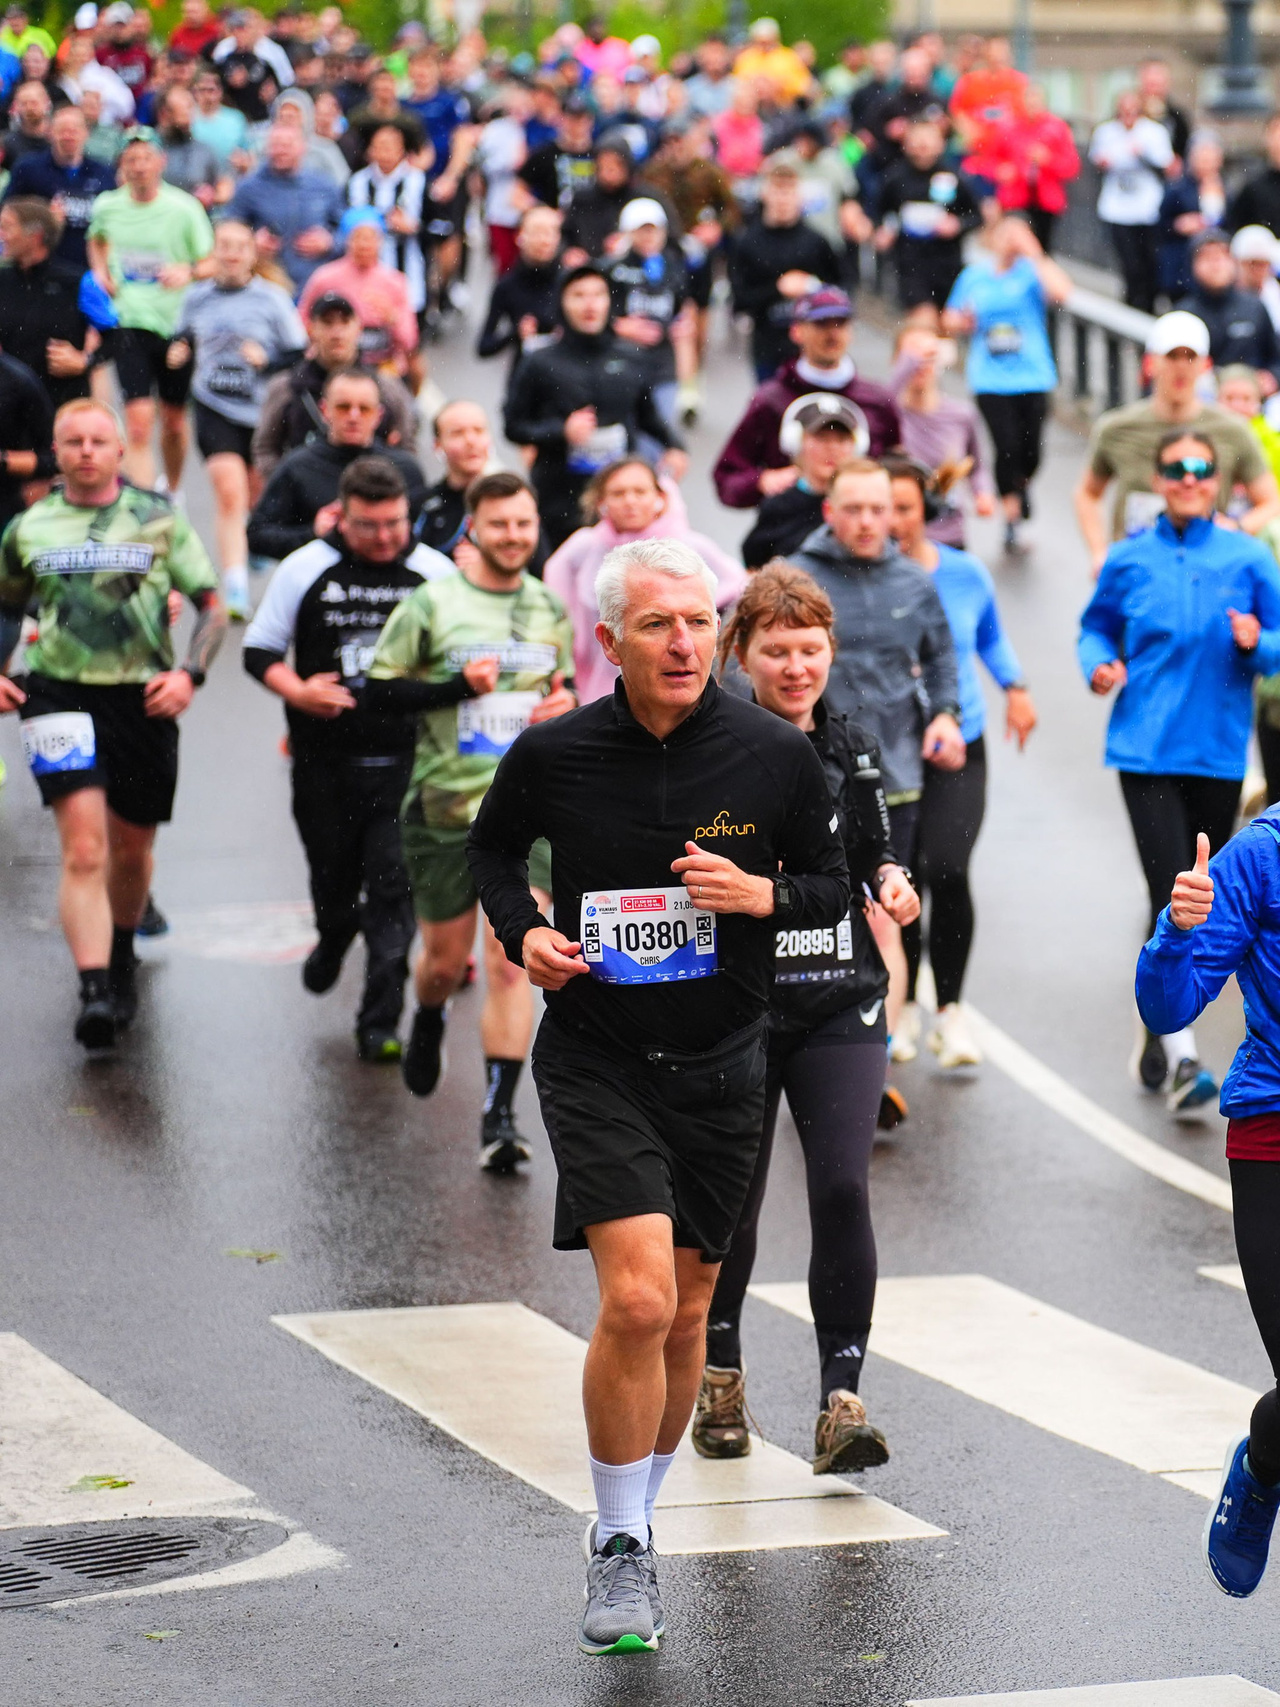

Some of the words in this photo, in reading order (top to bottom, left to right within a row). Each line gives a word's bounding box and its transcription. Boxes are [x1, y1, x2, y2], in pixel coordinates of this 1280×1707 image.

[694, 810, 756, 841] parkrun
[612, 919, 689, 953] 10380
[775, 927, 835, 958] 20895
[640, 955, 660, 966] CHRIS
